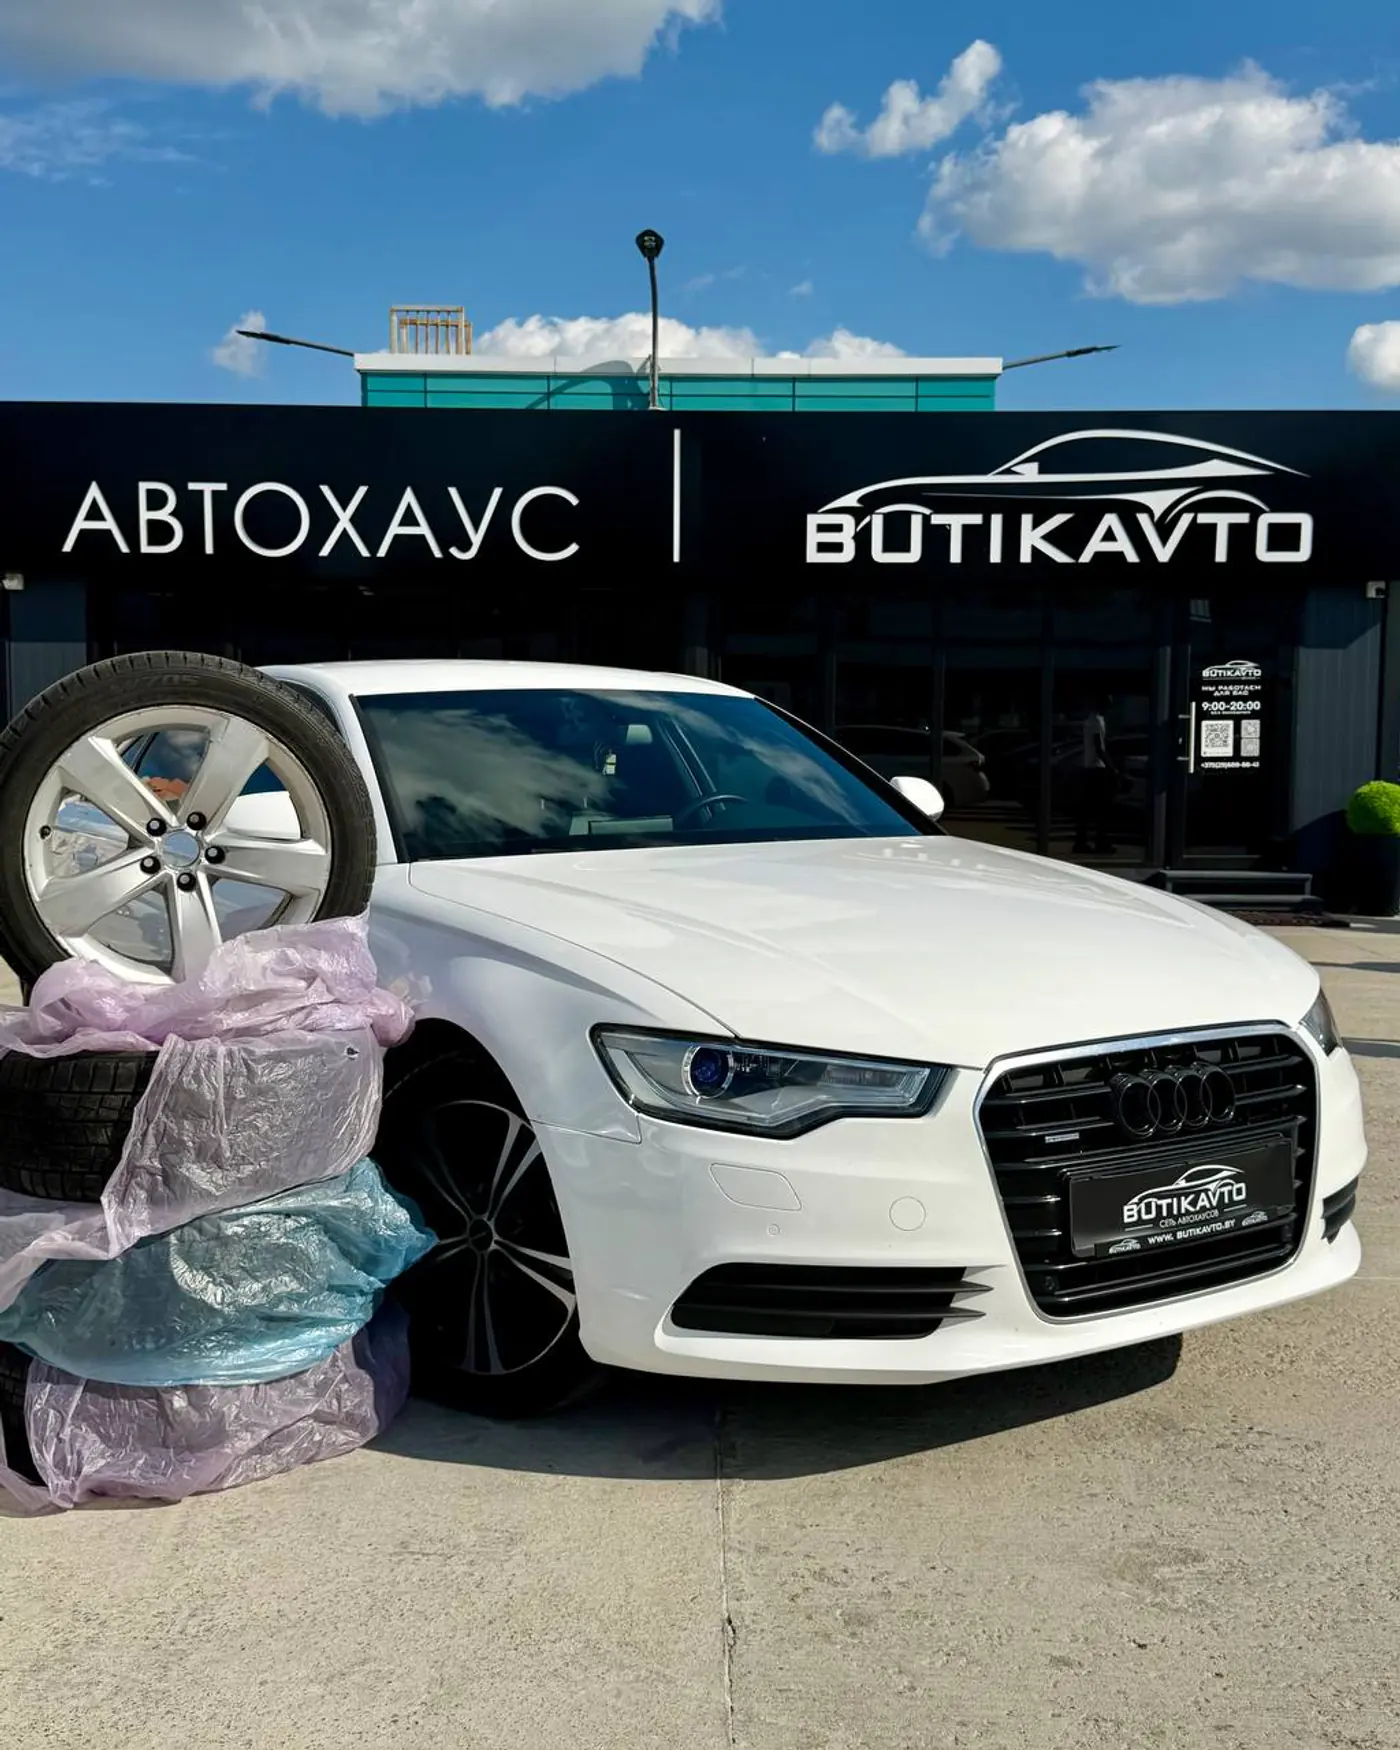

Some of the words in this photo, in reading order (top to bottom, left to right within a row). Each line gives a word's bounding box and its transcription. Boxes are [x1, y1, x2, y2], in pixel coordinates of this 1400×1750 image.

[62, 481, 580, 561] АВТОХАУС
[805, 511, 1314, 564] BUTIKAVTO
[1201, 701, 1261, 711] 9:00-20:00
[1122, 1182, 1247, 1224] BUTIKAVTO
